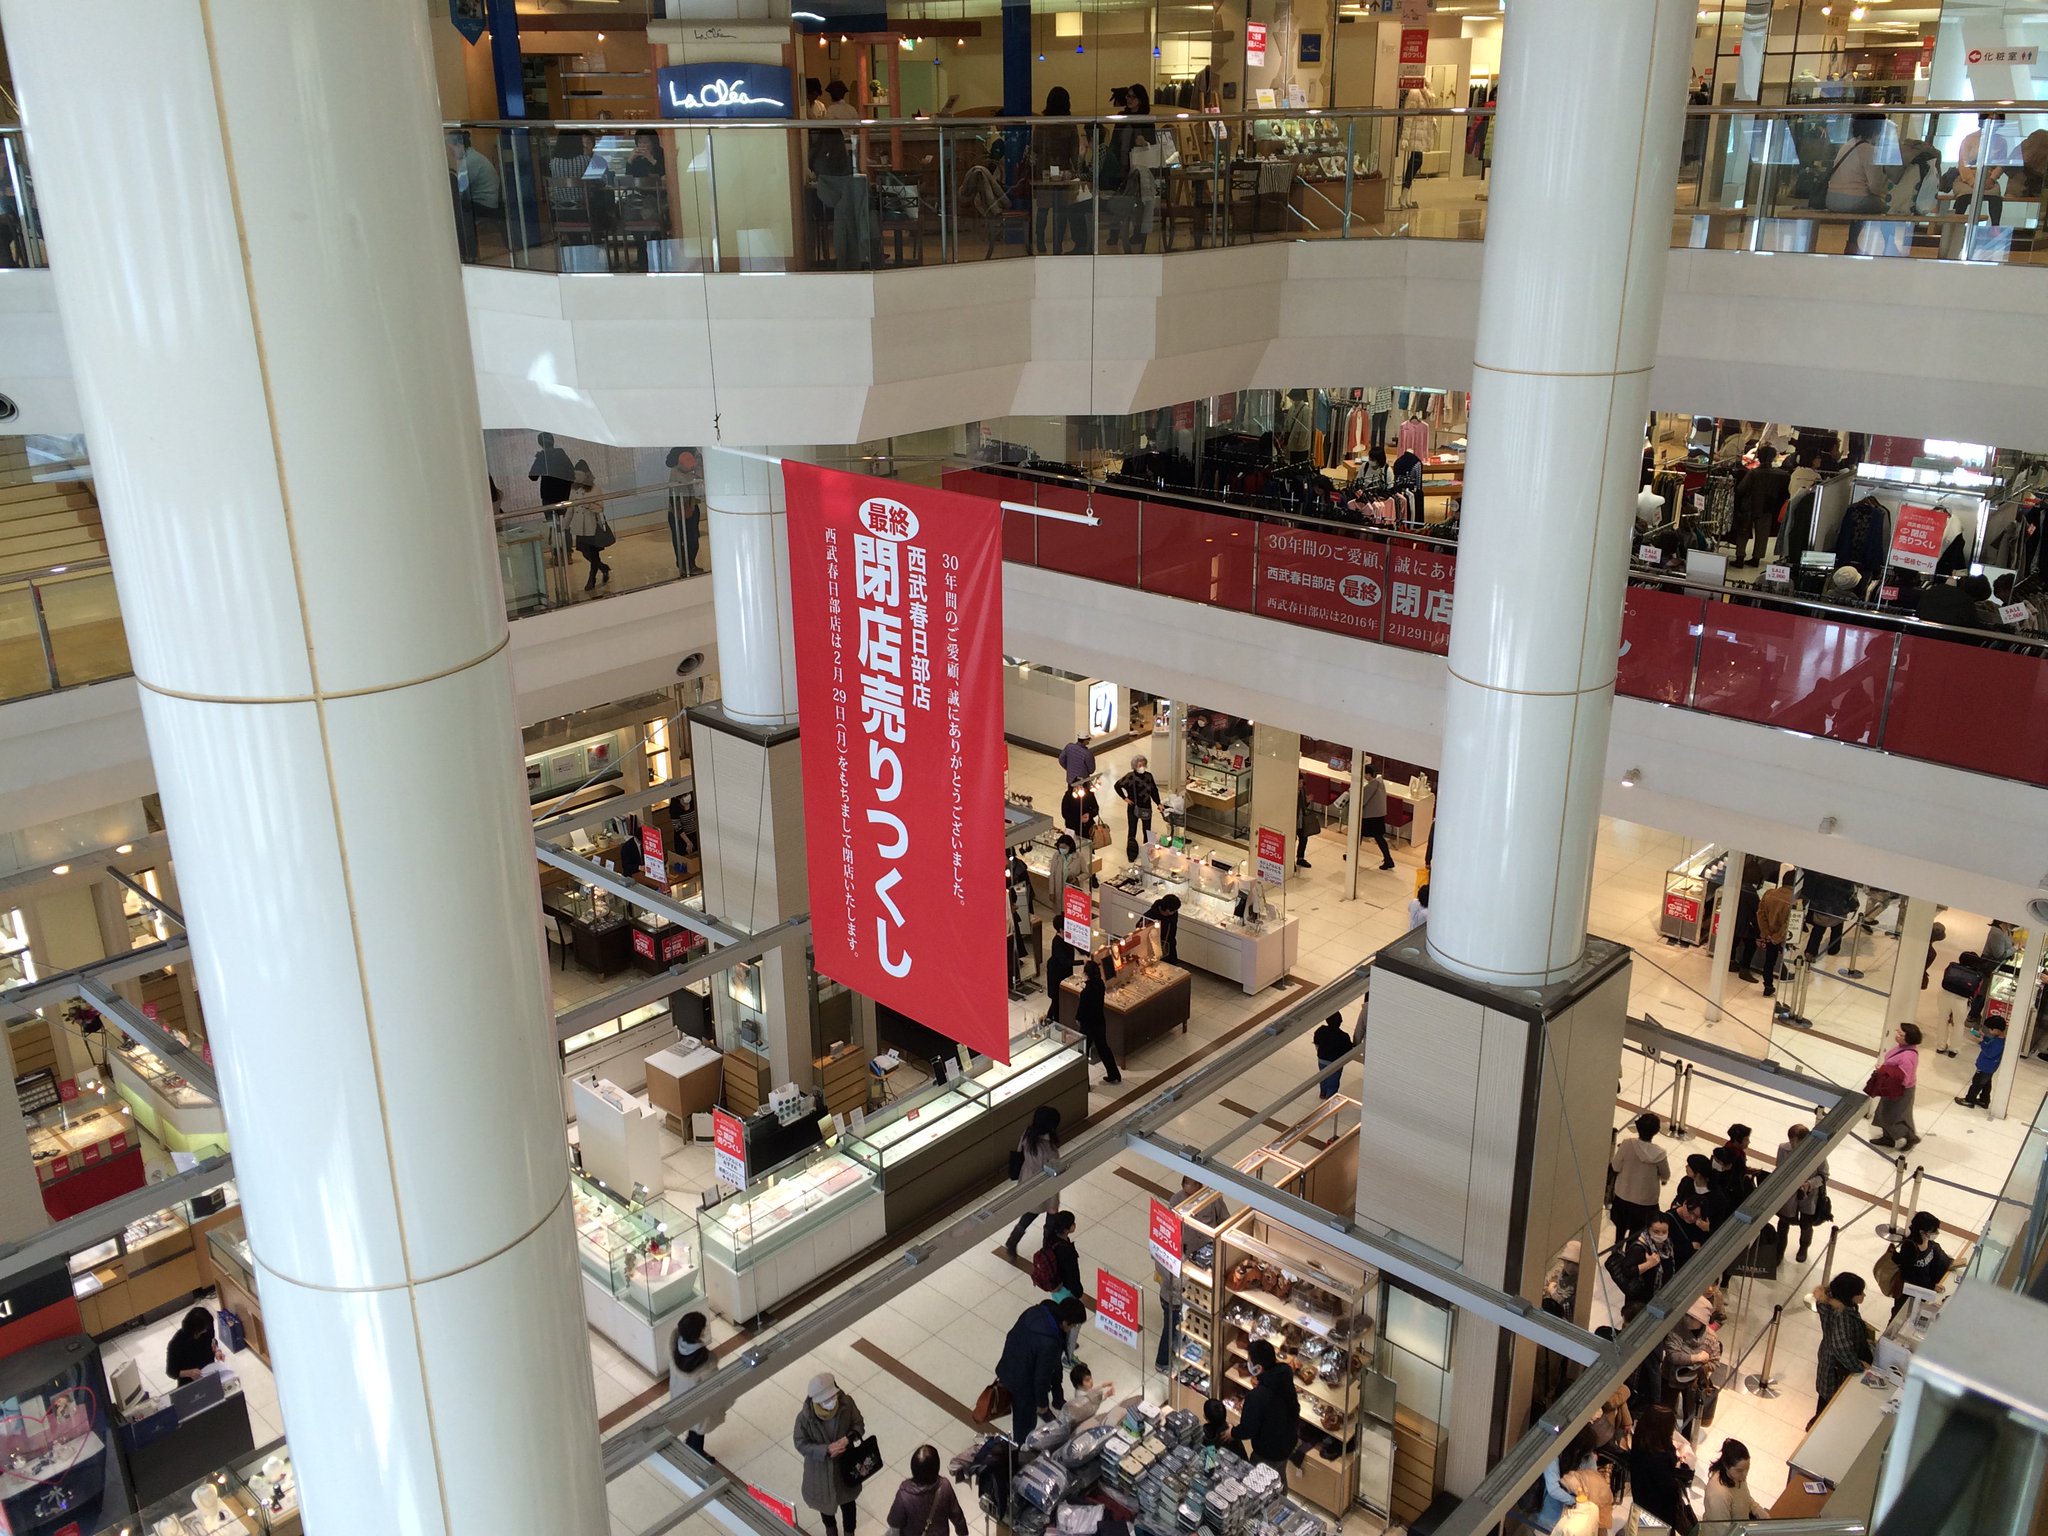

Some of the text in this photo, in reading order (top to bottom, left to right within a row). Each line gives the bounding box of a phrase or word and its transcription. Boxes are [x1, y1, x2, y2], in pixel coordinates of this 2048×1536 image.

[1984, 52, 2018, 61] 化粧室
[868, 502, 910, 538] 最終
[1267, 567, 1336, 593] 西武春日部店
[1343, 577, 1378, 604] 最終
[907, 545, 931, 711] 西武春日部店
[853, 532, 913, 978] 閉店売りつくし
[1101, 1298, 1134, 1323] 売りつくし
